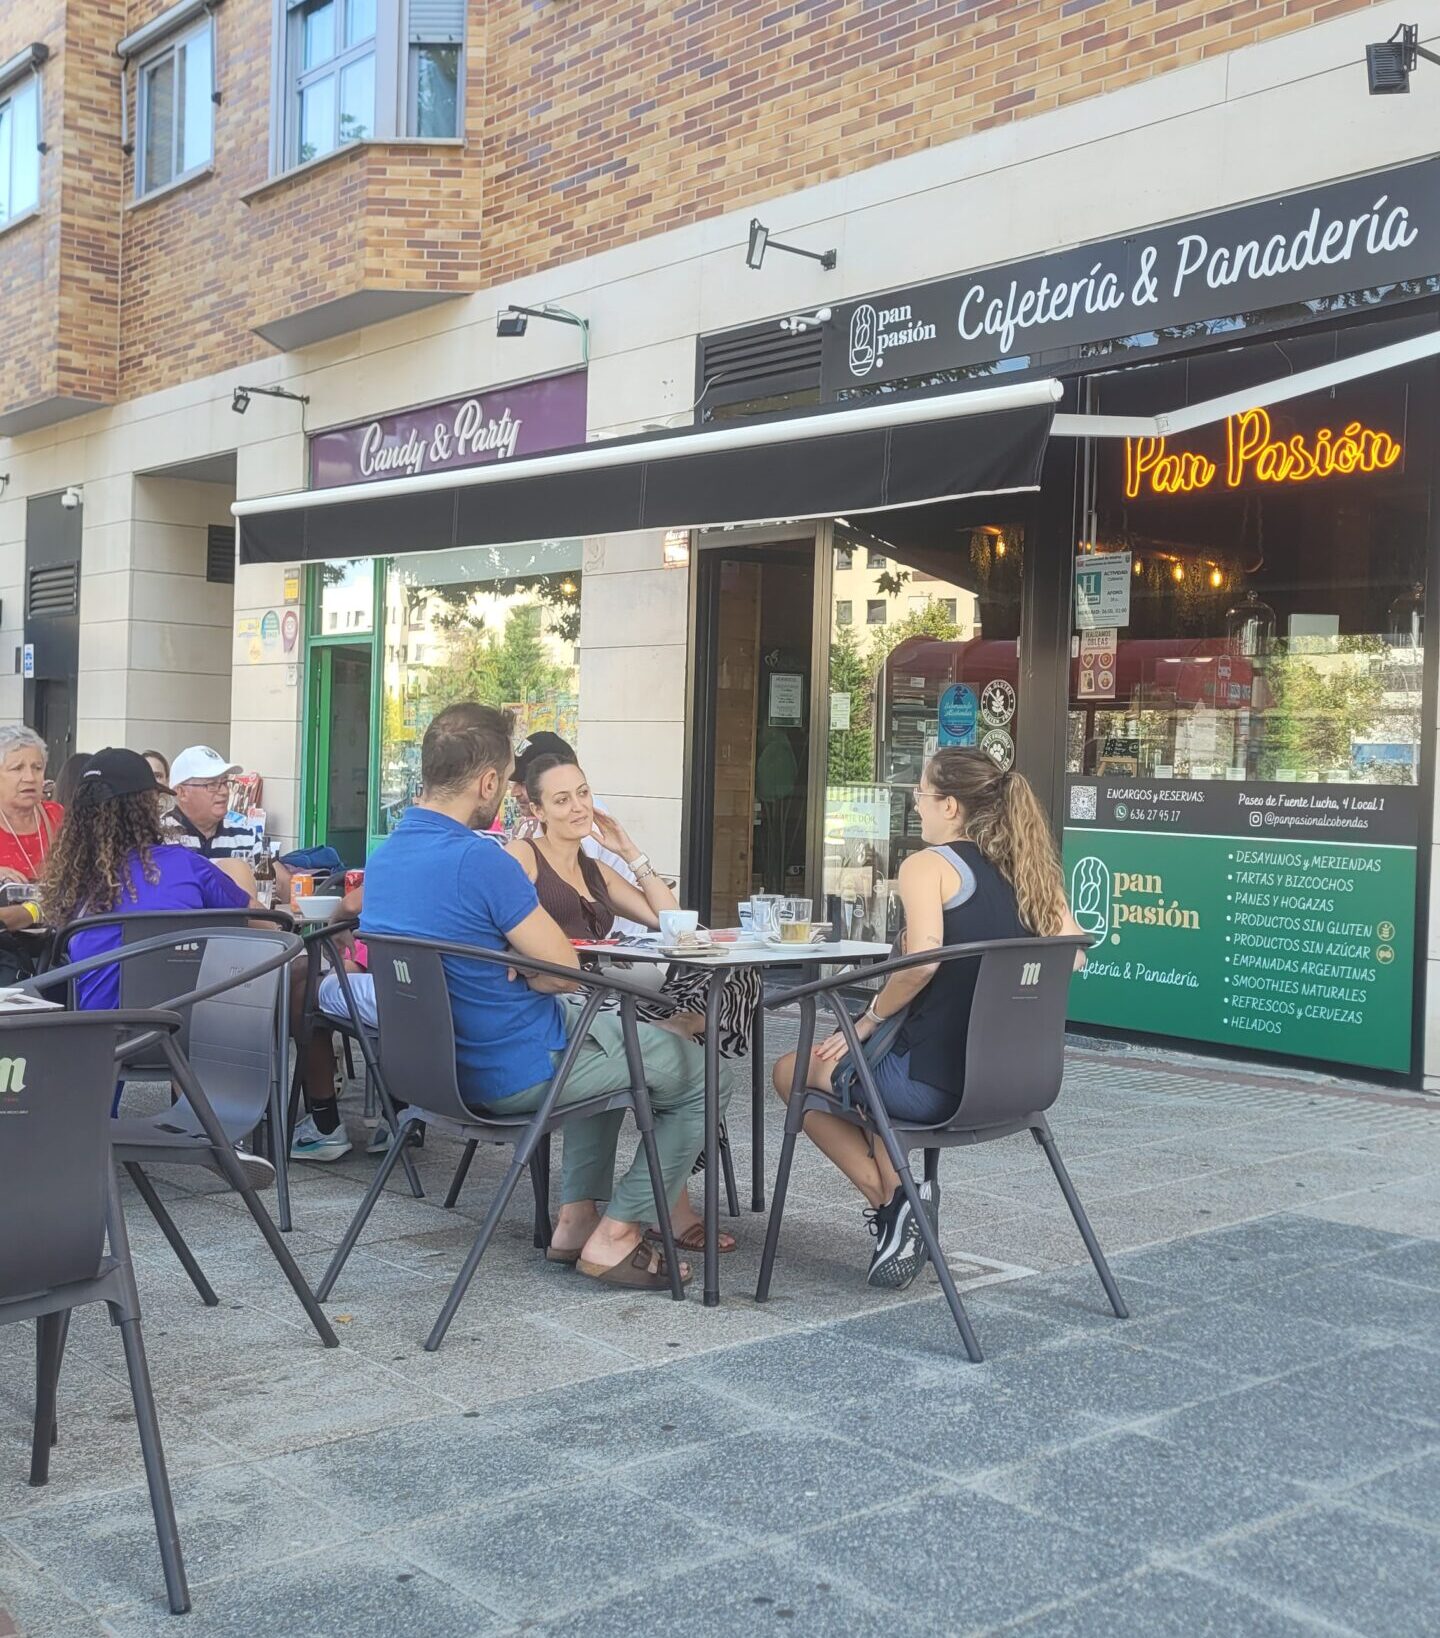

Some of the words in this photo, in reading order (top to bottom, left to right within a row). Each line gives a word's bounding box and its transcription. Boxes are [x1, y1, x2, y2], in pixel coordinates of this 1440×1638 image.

[958, 262, 1125, 353] Cafetería
[1132, 246, 1159, 306] &
[1173, 194, 1418, 298] Panadería
[878, 305, 912, 331] pan
[877, 321, 937, 354] pasión
[360, 422, 428, 475] Candy
[430, 423, 452, 462] &
[454, 399, 522, 458] Party
[1126, 436, 1216, 497] Pan
[1228, 407, 1401, 487] Pasión
[1107, 788, 1152, 801] ENCARGOS
[1153, 793, 1159, 803] y
[1159, 790, 1205, 802] RESERVAS:
[1238, 793, 1263, 806] Paseo
[1265, 795, 1278, 807] de
[1278, 794, 1309, 808] Fuente
[1310, 795, 1340, 810] Lucha,
[1351, 797, 1377, 811] Local
[1378, 798, 1385, 811] 1
[1130, 809, 1145, 820] 636
[1147, 810, 1157, 821] 27
[1159, 810, 1169, 821] 95
[1170, 811, 1181, 822] 17
[1265, 811, 1369, 828] @panpasionalcobendas
[1236, 850, 1302, 867] DESAYUNOS
[1303, 859, 1310, 870] y
[1311, 855, 1381, 872] MERIENDAS
[1112, 872, 1163, 897] pan
[1236, 871, 1274, 886] TARTAS
[1276, 874, 1284, 886] Y
[1285, 875, 1354, 892] BIZCOCHOS
[1111, 899, 1200, 930] pasión
[1234, 892, 1270, 907] PANES
[1272, 895, 1280, 907] Y
[1281, 896, 1335, 912] HOGAZAS
[1234, 912, 1300, 931] PRODUCTOS
[1302, 919, 1325, 933] SIN
[1326, 920, 1373, 938] GLUTEN
[1233, 933, 1300, 952] PRODUCTOS
[1301, 940, 1324, 954] SIN
[1326, 942, 1371, 960] AZÚCAR
[1123, 962, 1132, 980] &
[1135, 963, 1199, 988] Panadería
[1232, 953, 1299, 973] EMPANADAS
[1300, 961, 1376, 982] ARGENTINAS
[1232, 975, 1299, 994] SMOOTHIES
[1301, 984, 1367, 1003] NATURALES
[1232, 994, 1295, 1015] REFRESCOS
[1296, 1008, 1303, 1020] y
[1304, 1005, 1363, 1025] CERVEZAS
[1231, 1016, 1282, 1034] HELADOS
